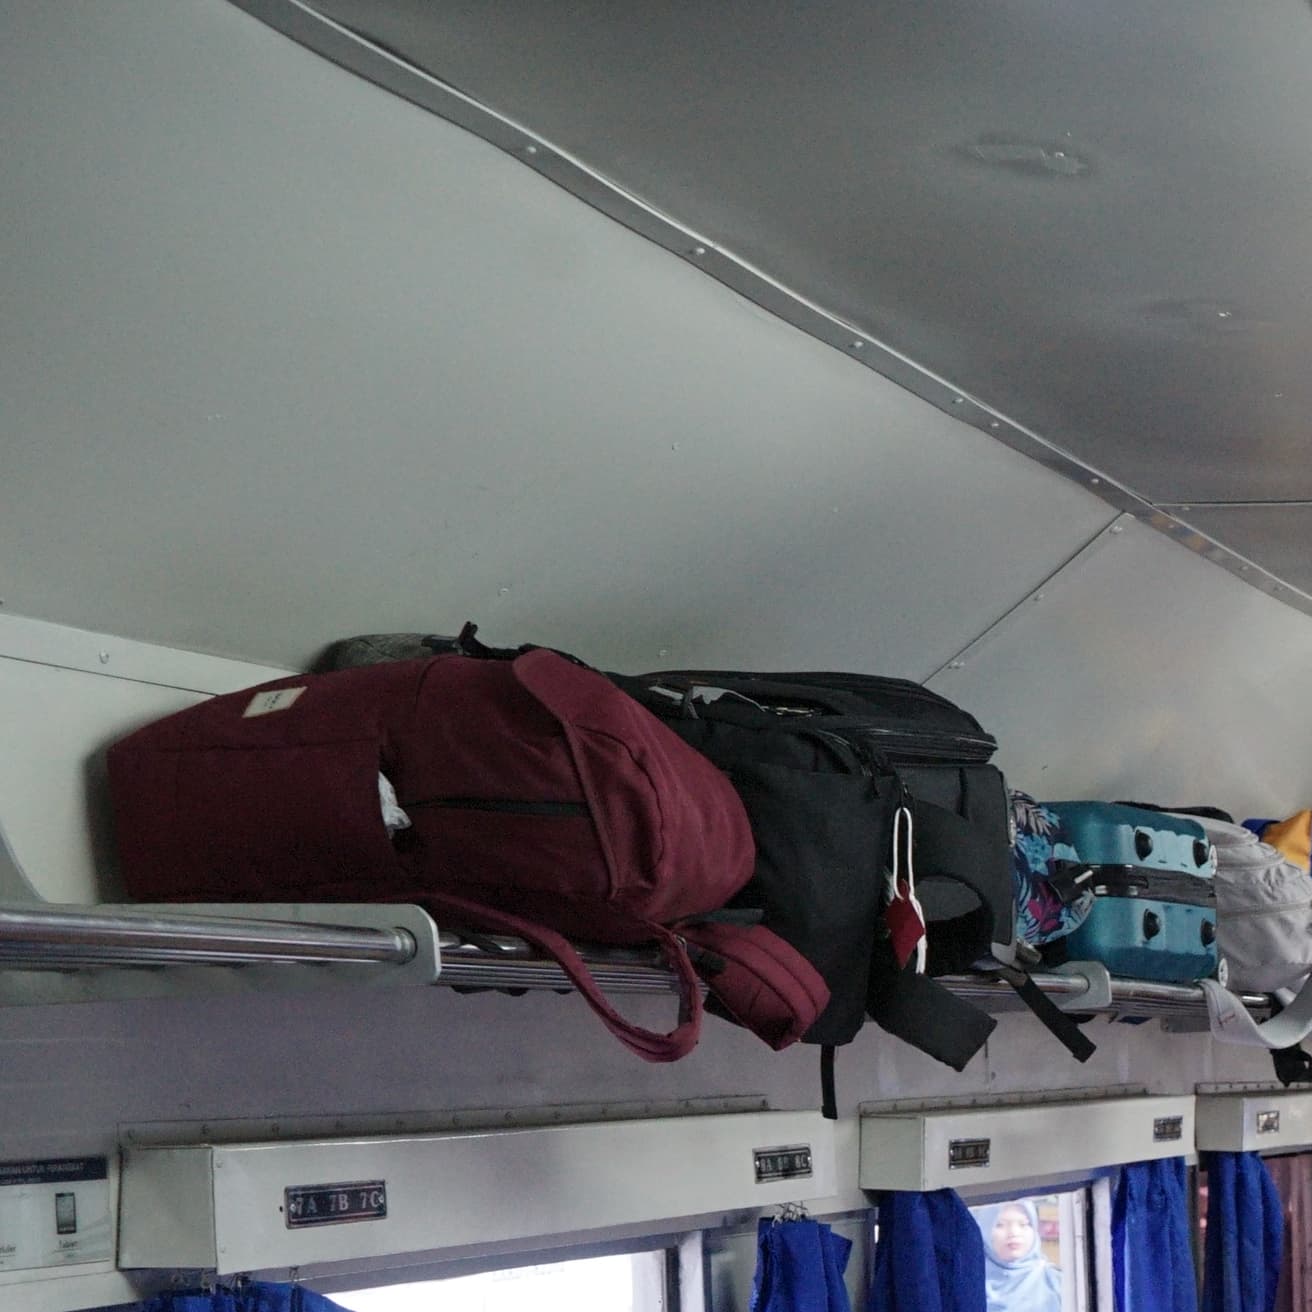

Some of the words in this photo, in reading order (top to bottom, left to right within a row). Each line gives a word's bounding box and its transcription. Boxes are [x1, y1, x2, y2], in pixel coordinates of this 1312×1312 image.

[295, 1197, 317, 1215] 7A
[329, 1193, 349, 1212] 7B
[360, 1190, 379, 1209] 7C
